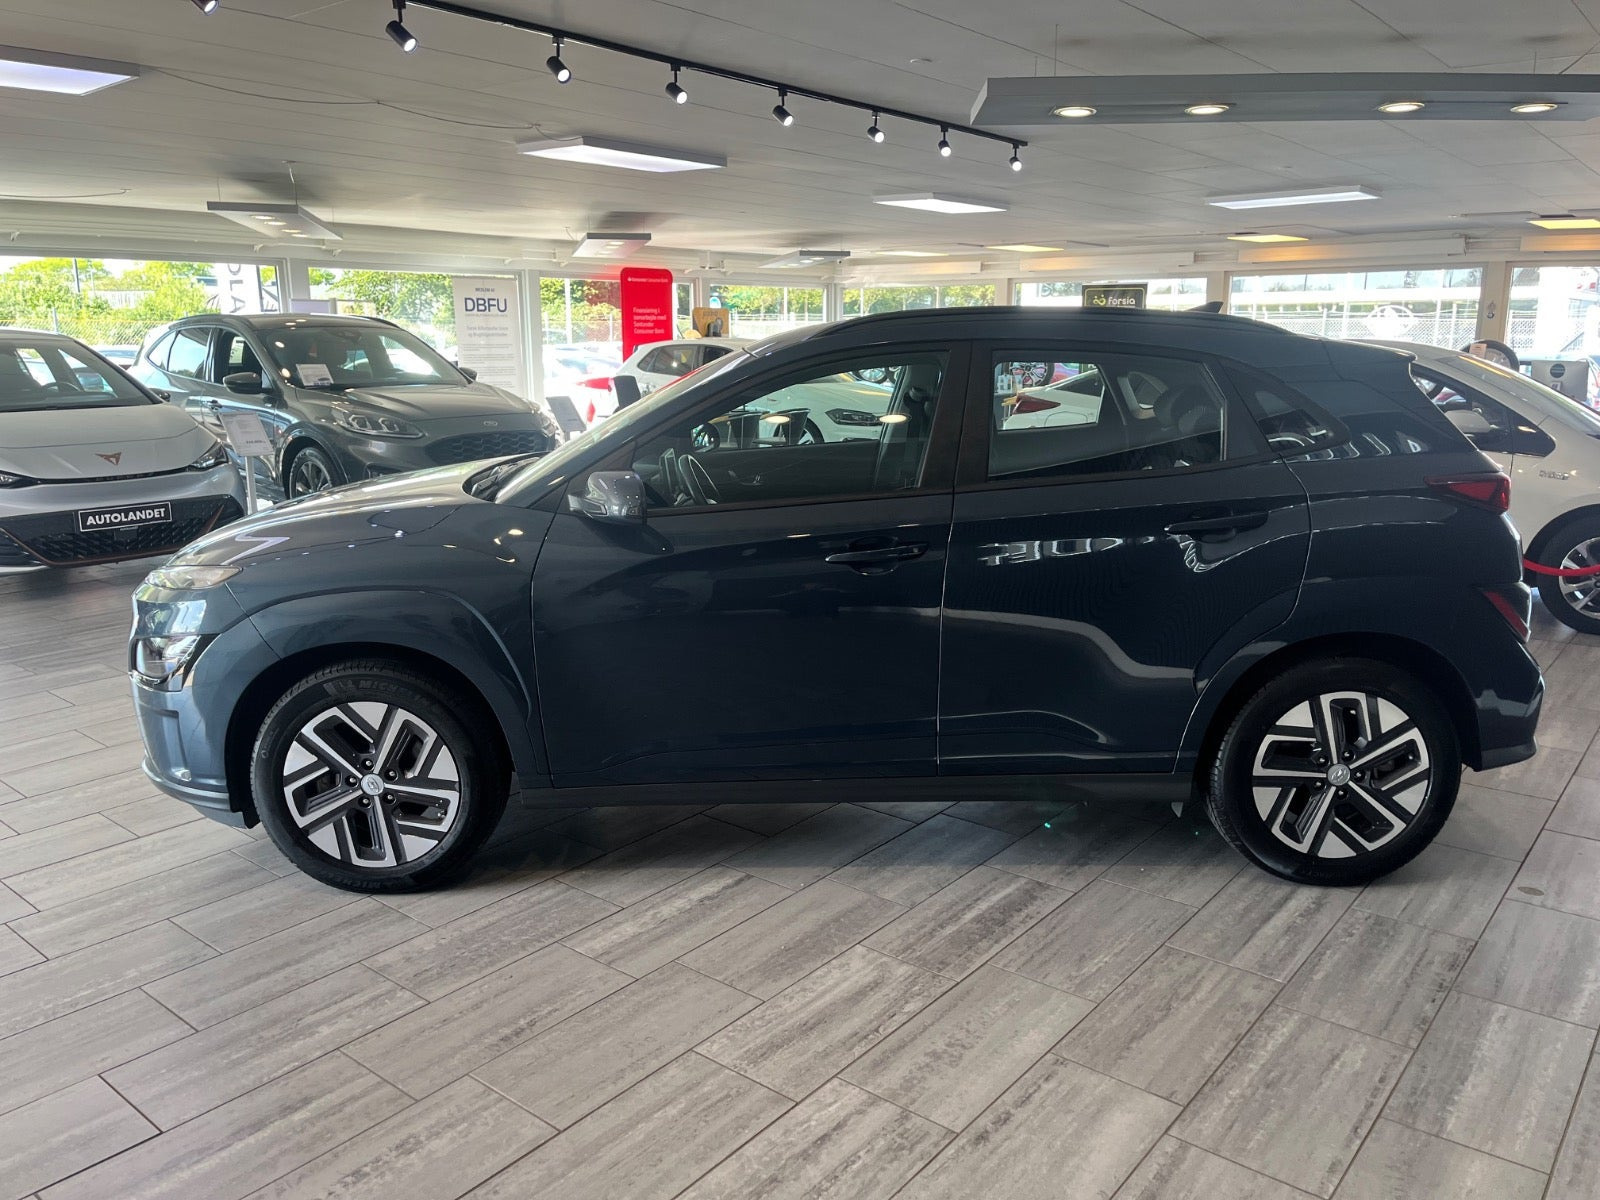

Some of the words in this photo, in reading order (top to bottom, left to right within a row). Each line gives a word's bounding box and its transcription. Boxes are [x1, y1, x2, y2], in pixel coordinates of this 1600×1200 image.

[464, 297, 508, 313] DBFU
[1108, 296, 1136, 305] forsia
[86, 508, 166, 526] AUTOLANDET
